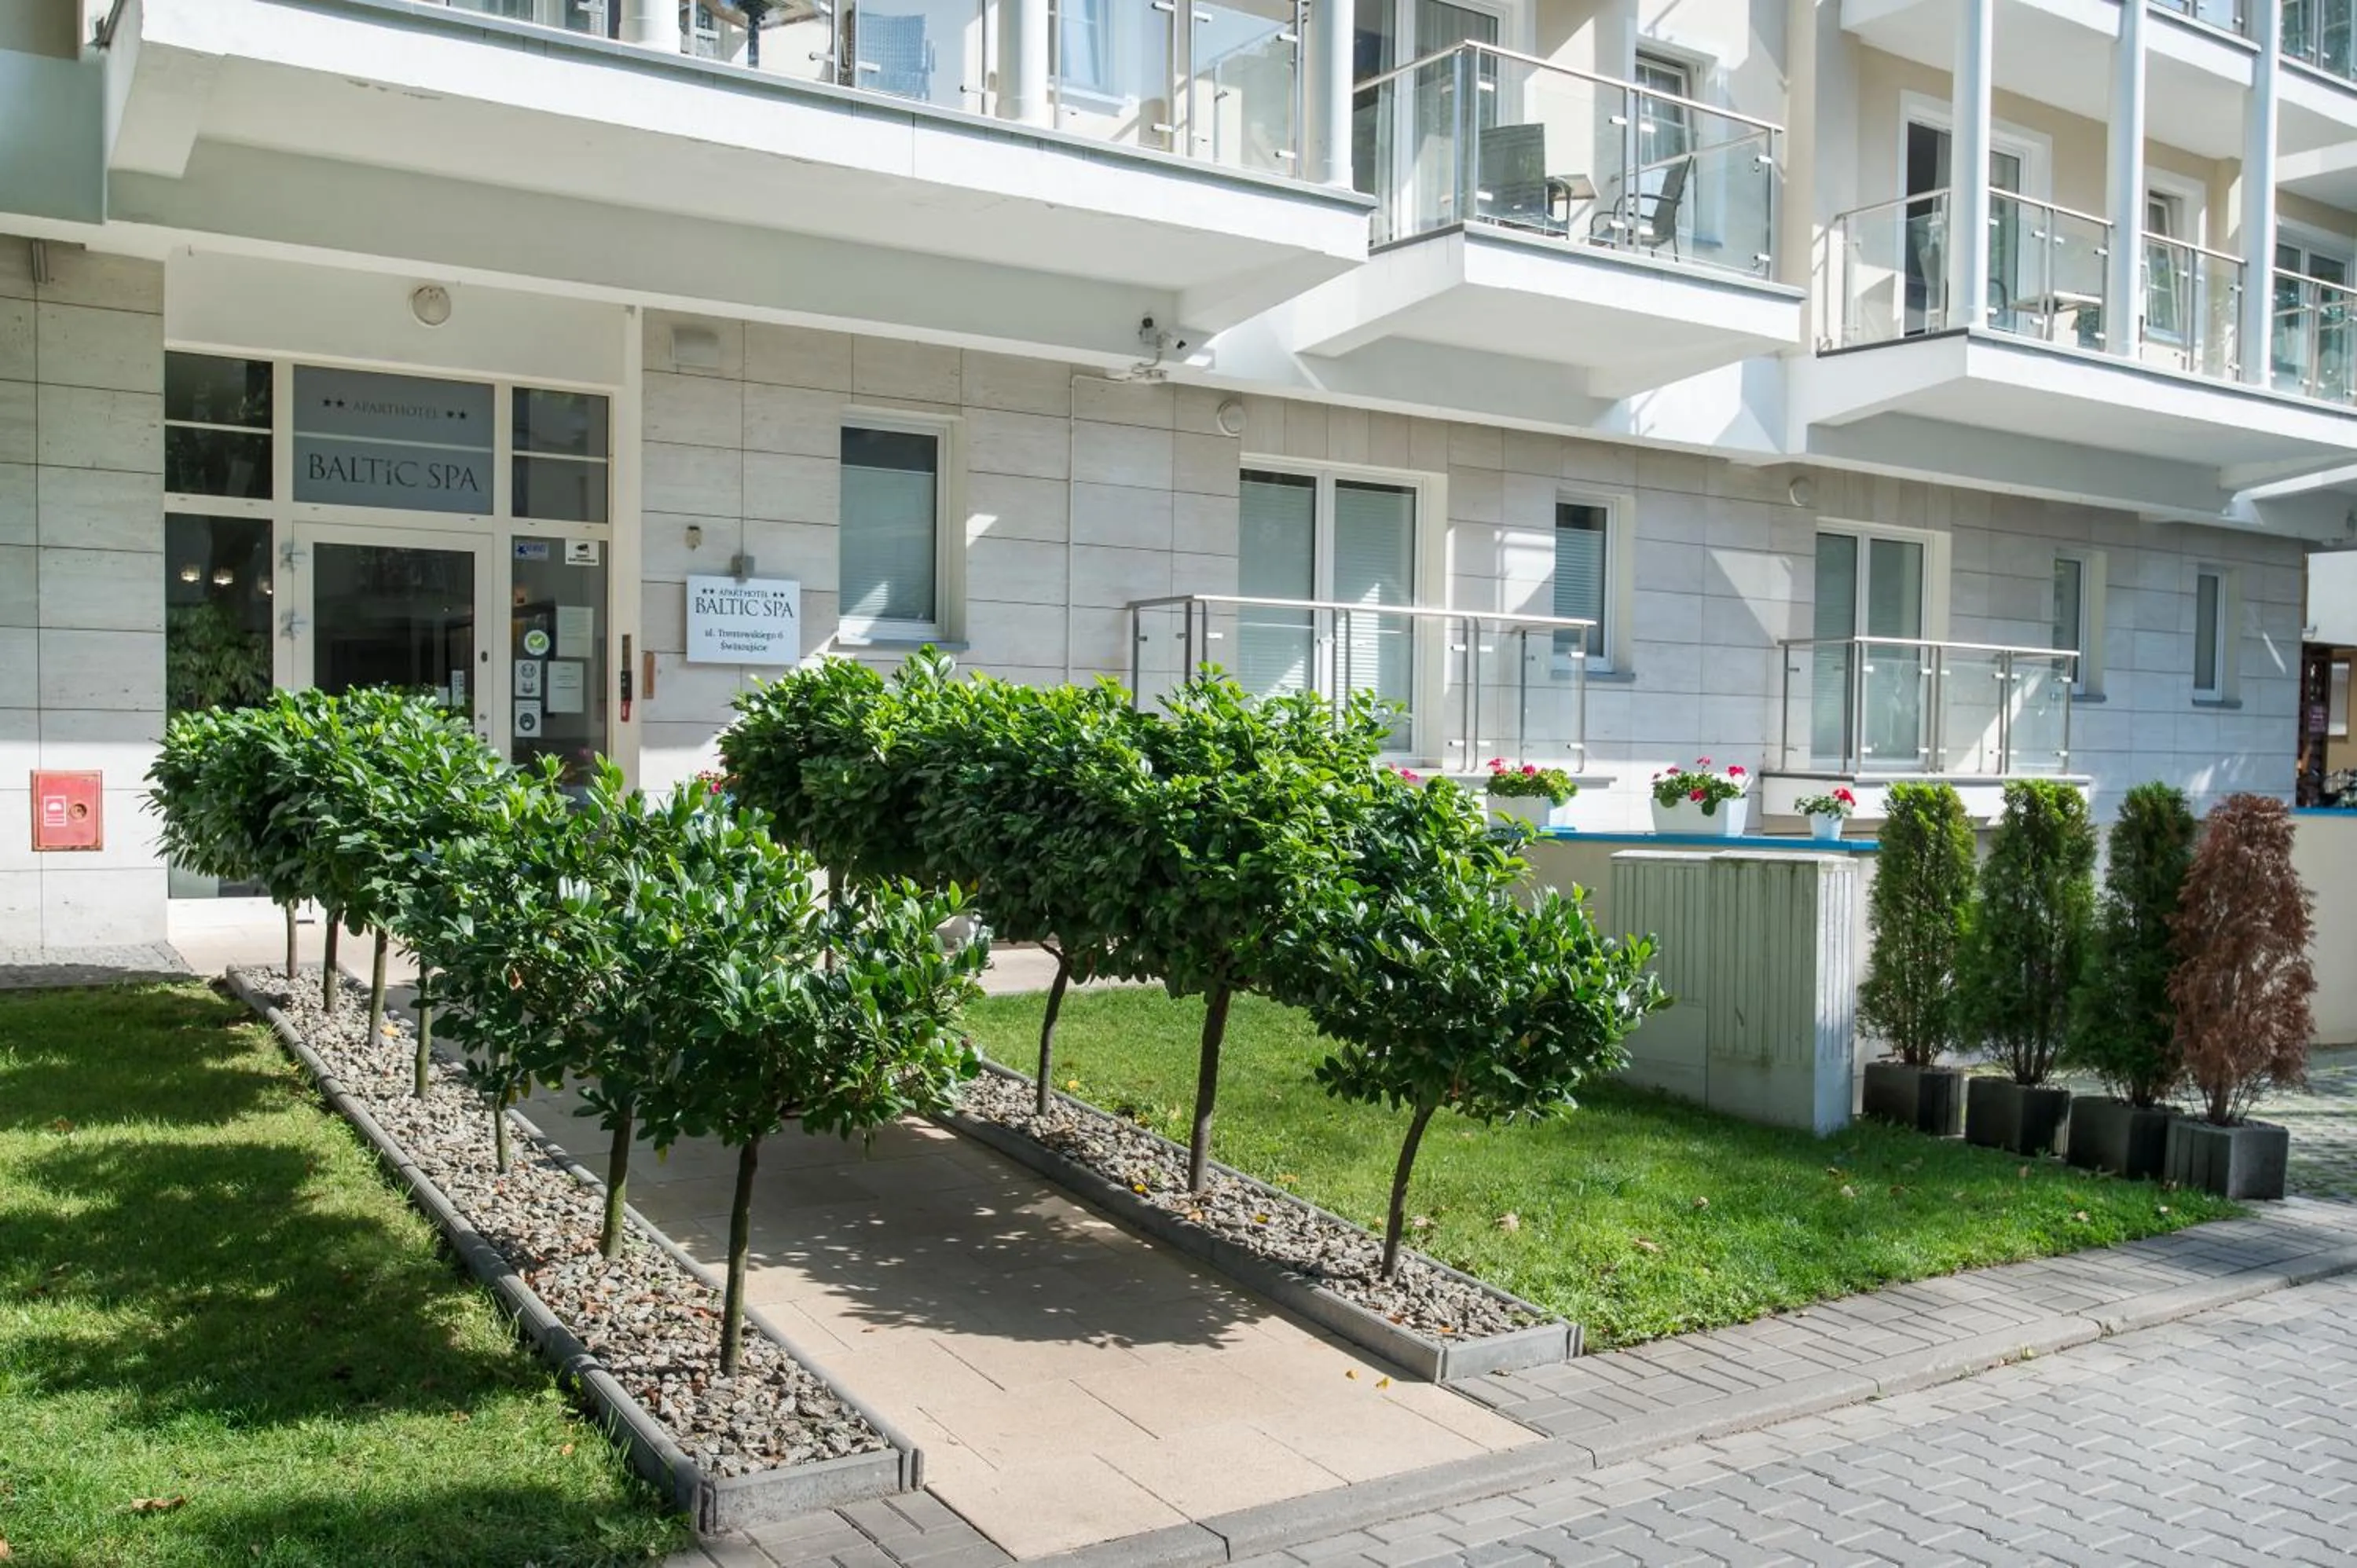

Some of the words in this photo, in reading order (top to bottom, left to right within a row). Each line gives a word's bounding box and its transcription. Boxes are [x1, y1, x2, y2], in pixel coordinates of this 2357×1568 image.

[354, 400, 438, 419] APARTHOTEL
[427, 463, 478, 492] SPA
[719, 588, 768, 598] APARTHOTEL
[695, 596, 759, 616] BALTIC
[763, 599, 794, 617] SPA
